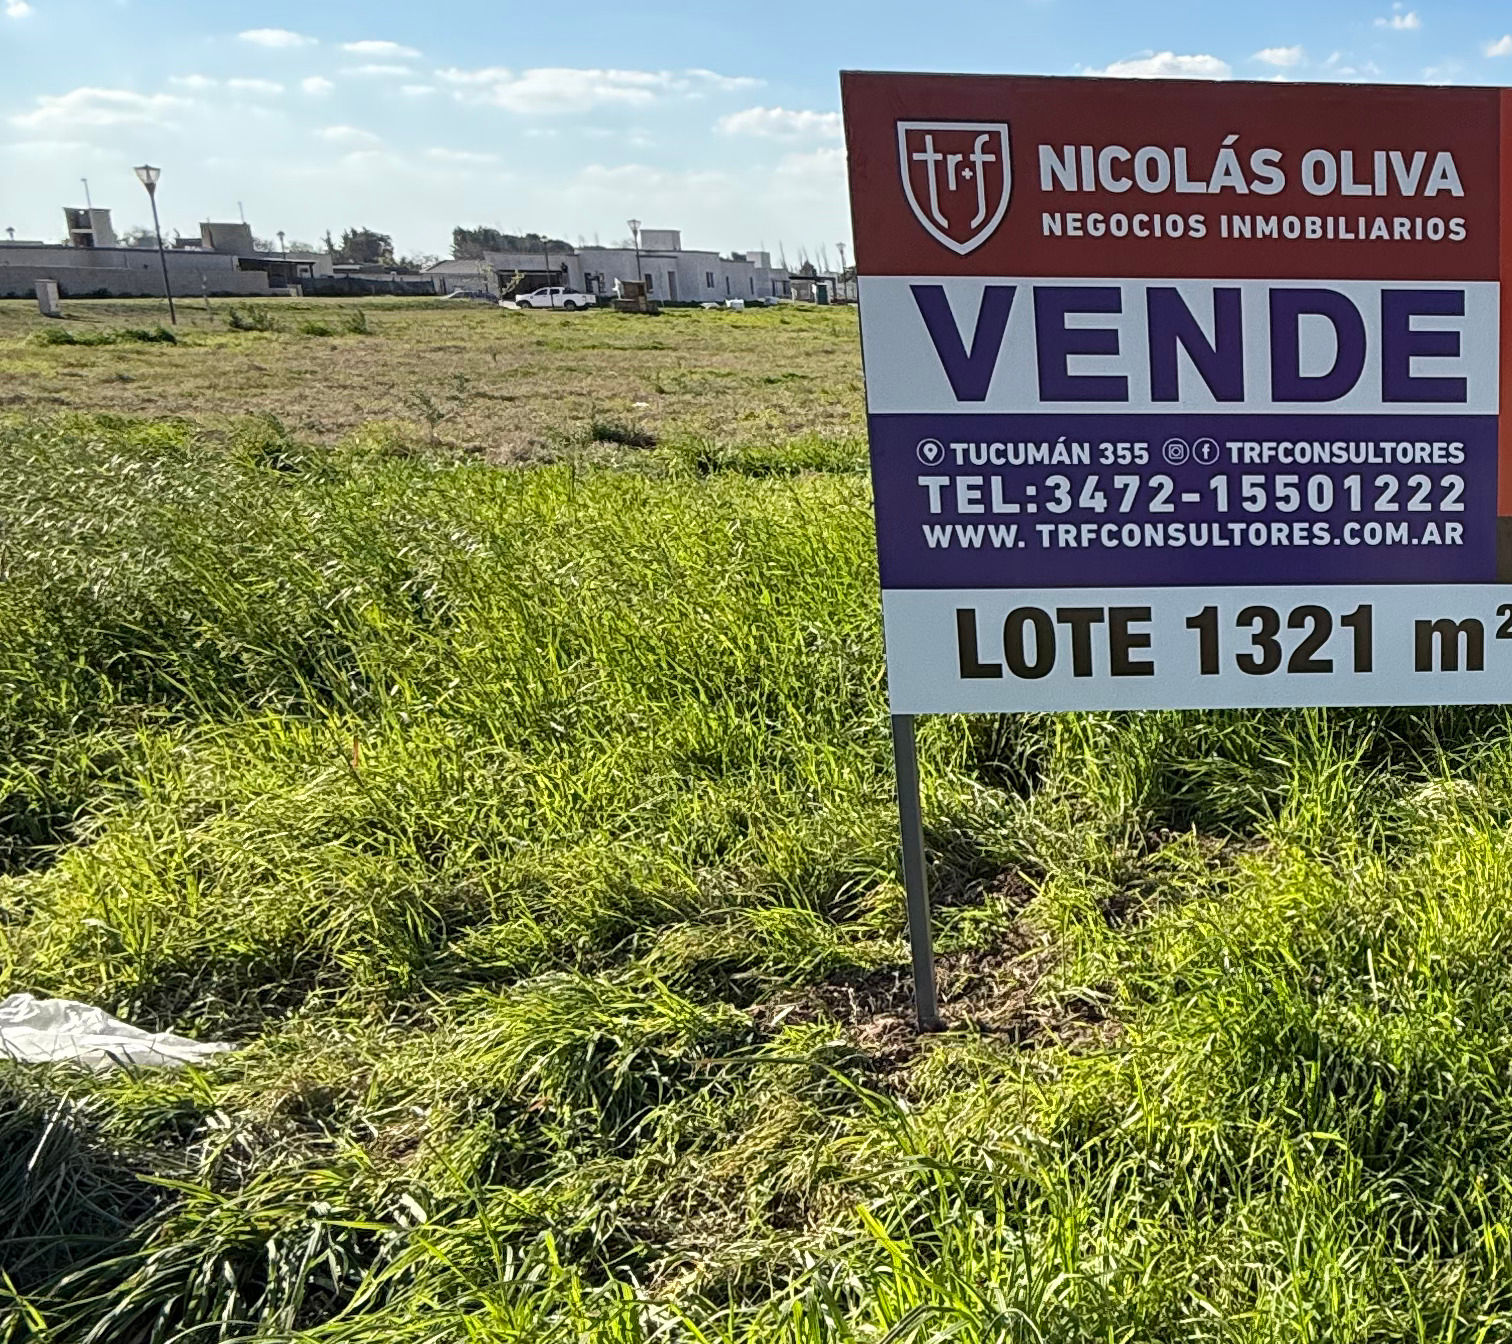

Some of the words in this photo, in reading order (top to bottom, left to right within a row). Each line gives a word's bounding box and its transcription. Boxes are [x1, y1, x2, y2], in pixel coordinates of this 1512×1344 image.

[1038, 135, 1287, 196] NICOLÁS
[1301, 149, 1466, 198] OLIVA
[1042, 212, 1207, 238] NEGOCIOS
[1220, 215, 1468, 241] INMOBILIARIOS
[909, 284, 1469, 404] VENDE
[950, 436, 1094, 465] TUCUMÁN
[1099, 442, 1150, 465] 355
[1226, 441, 1466, 465] TRFCONSULTORES
[956, 606, 1154, 680] LOTE
[1185, 603, 1375, 675] 1321
